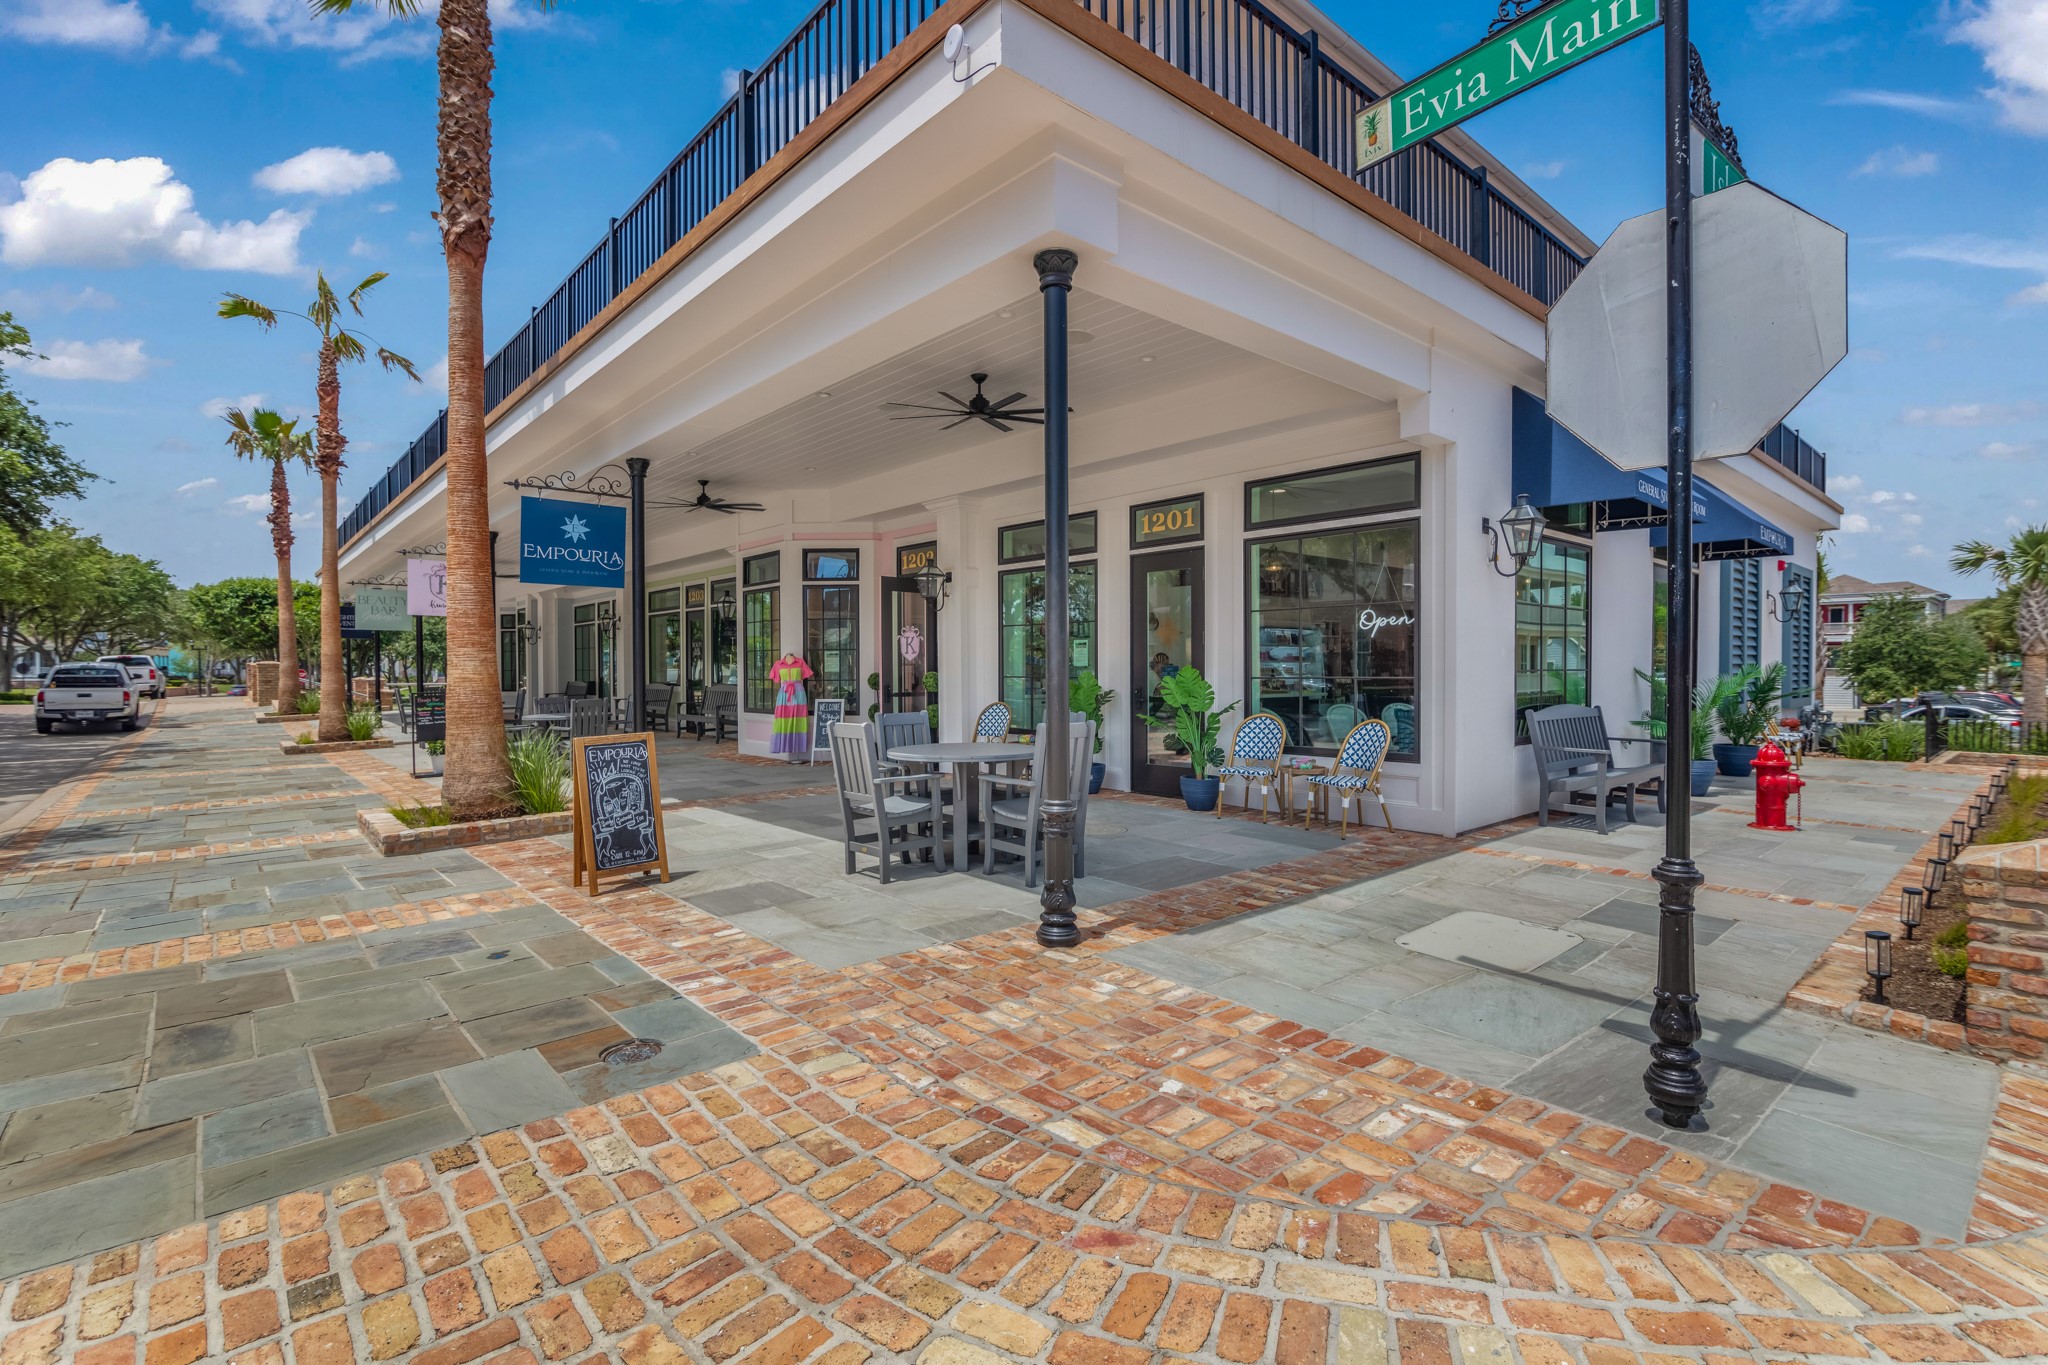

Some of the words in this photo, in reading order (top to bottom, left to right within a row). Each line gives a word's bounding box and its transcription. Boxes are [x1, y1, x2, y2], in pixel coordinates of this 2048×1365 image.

[1401, 68, 1490, 138] Evia
[1505, 0, 1643, 86] Main
[1638, 479, 1661, 500] GENERAL
[1141, 507, 1195, 534] 1201
[1760, 525, 1787, 549] EMPOURIA
[523, 543, 624, 571] EMPOURIA
[357, 595, 408, 606] BEAUTY
[370, 606, 400, 617] BAR
[1359, 608, 1415, 638] Open
[903, 636, 917, 655] K
[589, 746, 648, 762] EMPOURIA
